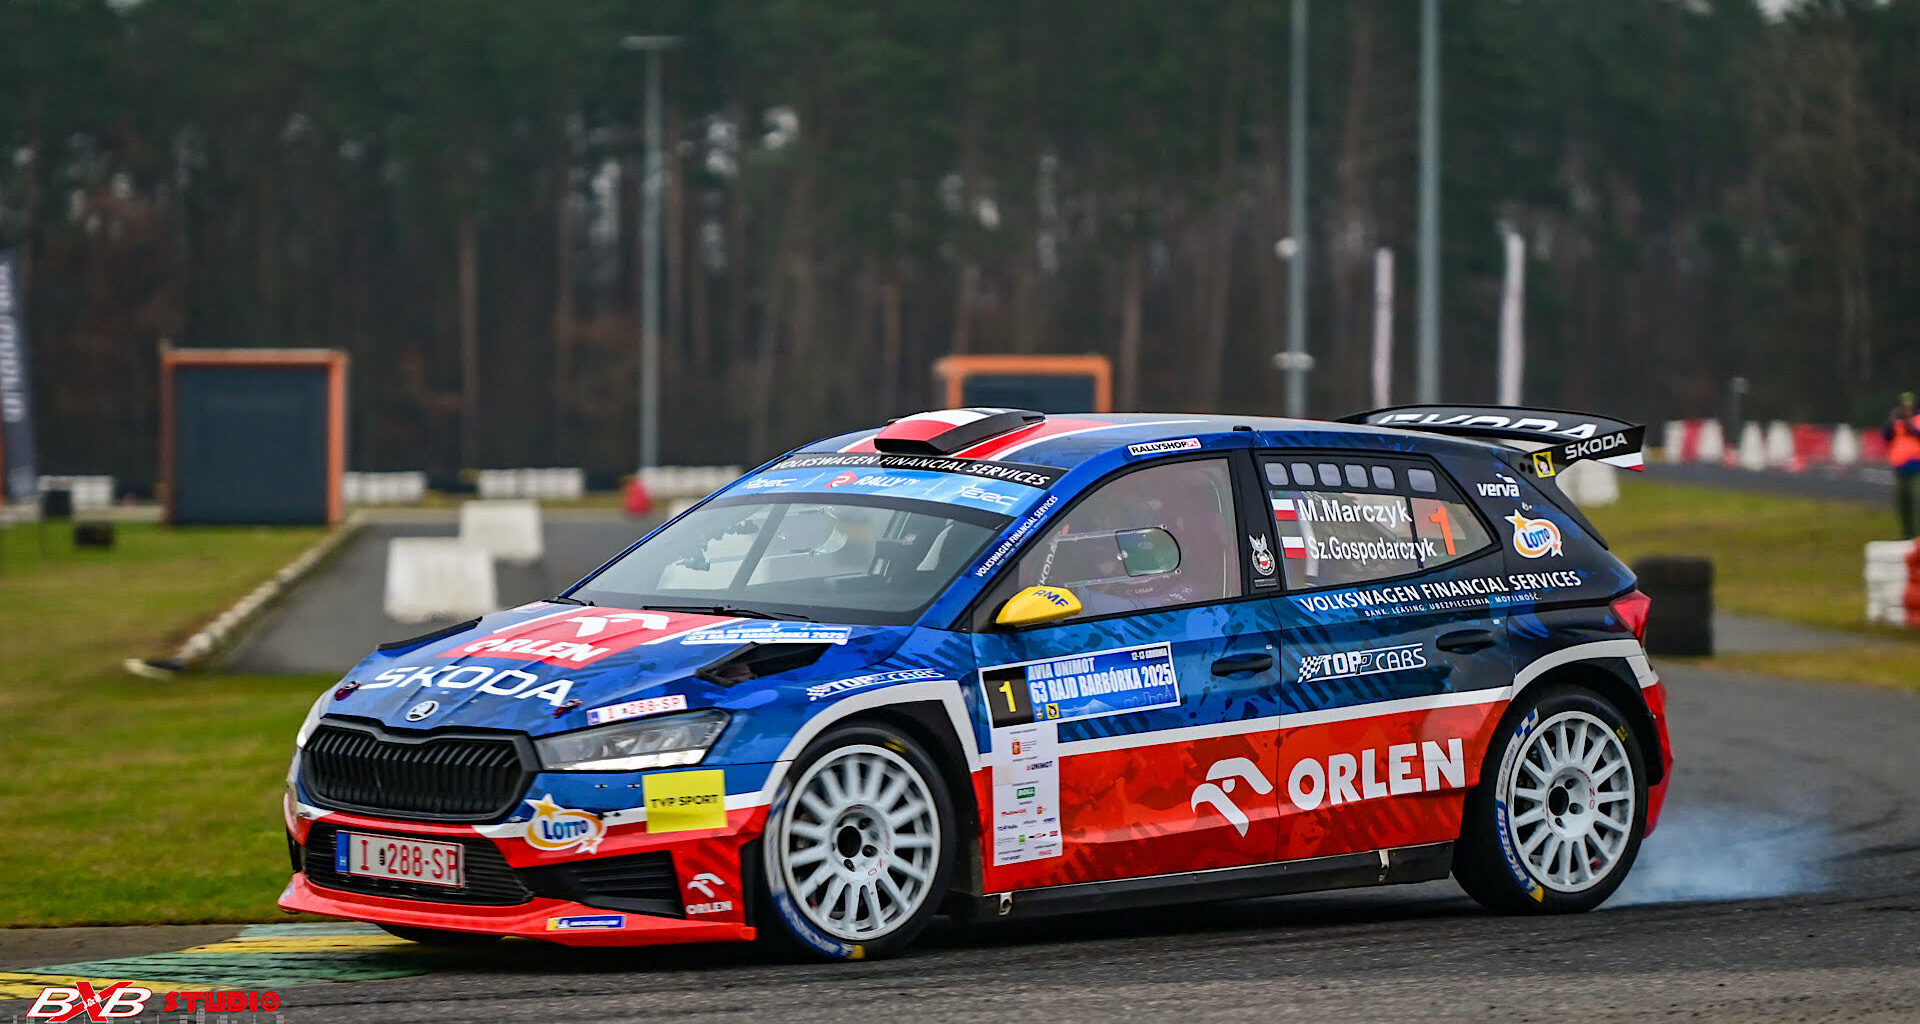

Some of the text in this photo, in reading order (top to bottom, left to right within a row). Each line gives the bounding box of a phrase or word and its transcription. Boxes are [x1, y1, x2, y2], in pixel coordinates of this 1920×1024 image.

[1131, 441, 1187, 453] RALLYSHOP
[771, 456, 1051, 486] VOLKSWAGEN FINANCIAL SERVICES
[1477, 483, 1520, 497] verva
[1297, 498, 1413, 528] M.Marczyk
[975, 540, 1012, 577] VOLKSWAGEN
[1009, 516, 1038, 544] FINANCIAL
[1033, 495, 1059, 518] SERVICES
[1429, 506, 1457, 556] 1
[1037, 540, 1059, 587] KODA
[1307, 535, 1438, 565] Sz.Gospodarczyk
[1033, 589, 1070, 607] RMF
[1300, 570, 1582, 613] VOLKSWAGEN FINANCIAL SERVICES
[1364, 609, 1390, 617] BANK.
[1392, 605, 1427, 615] LEASING.
[463, 638, 611, 662] ORLEN
[1376, 647, 1427, 671] CARS
[1028, 657, 1096, 681] AVIA UNIMOT
[1029, 663, 1173, 703] 63 RAJD BARBÓRKA 2025
[998, 680, 1017, 713] 1
[1288, 738, 1466, 811] ORLEN
[651, 794, 718, 808] TVP SPORT
[685, 901, 733, 914] ORLEN
